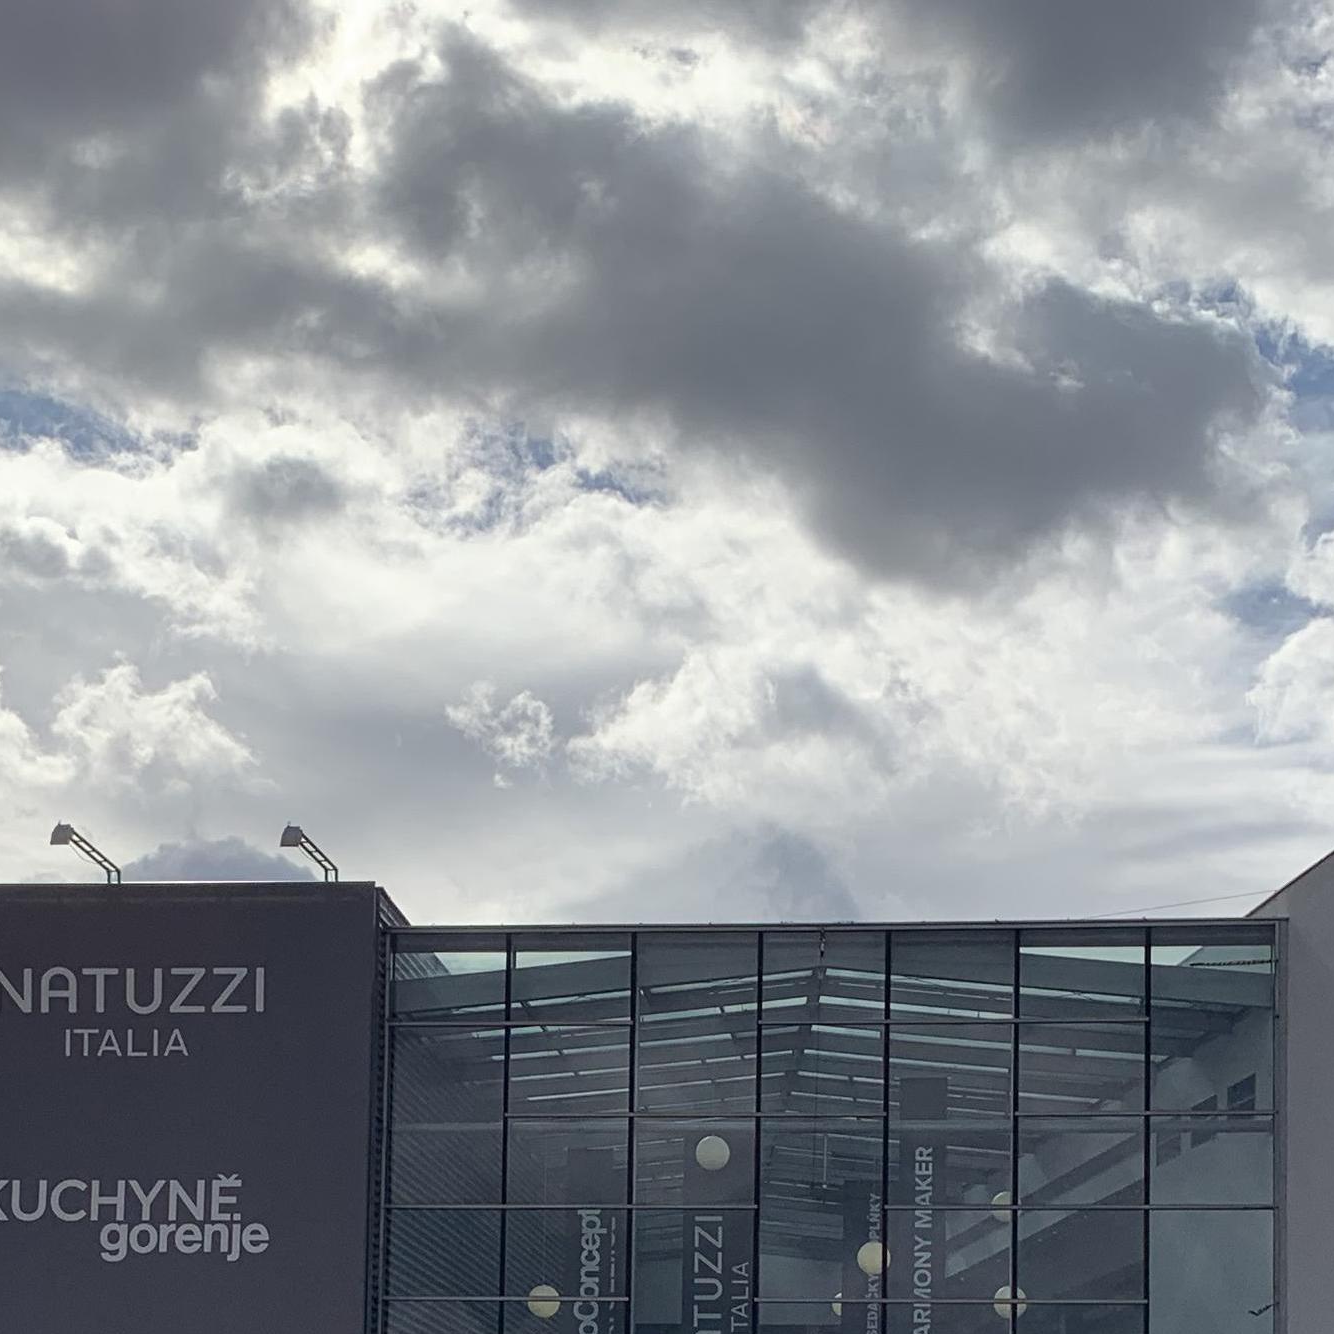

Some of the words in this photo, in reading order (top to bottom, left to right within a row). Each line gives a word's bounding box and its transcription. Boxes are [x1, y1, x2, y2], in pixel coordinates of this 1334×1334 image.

[65, 1028, 189, 1057] ITALIA
[914, 1146, 934, 1228] MAKER
[100, 1213, 270, 1262] gorenje
